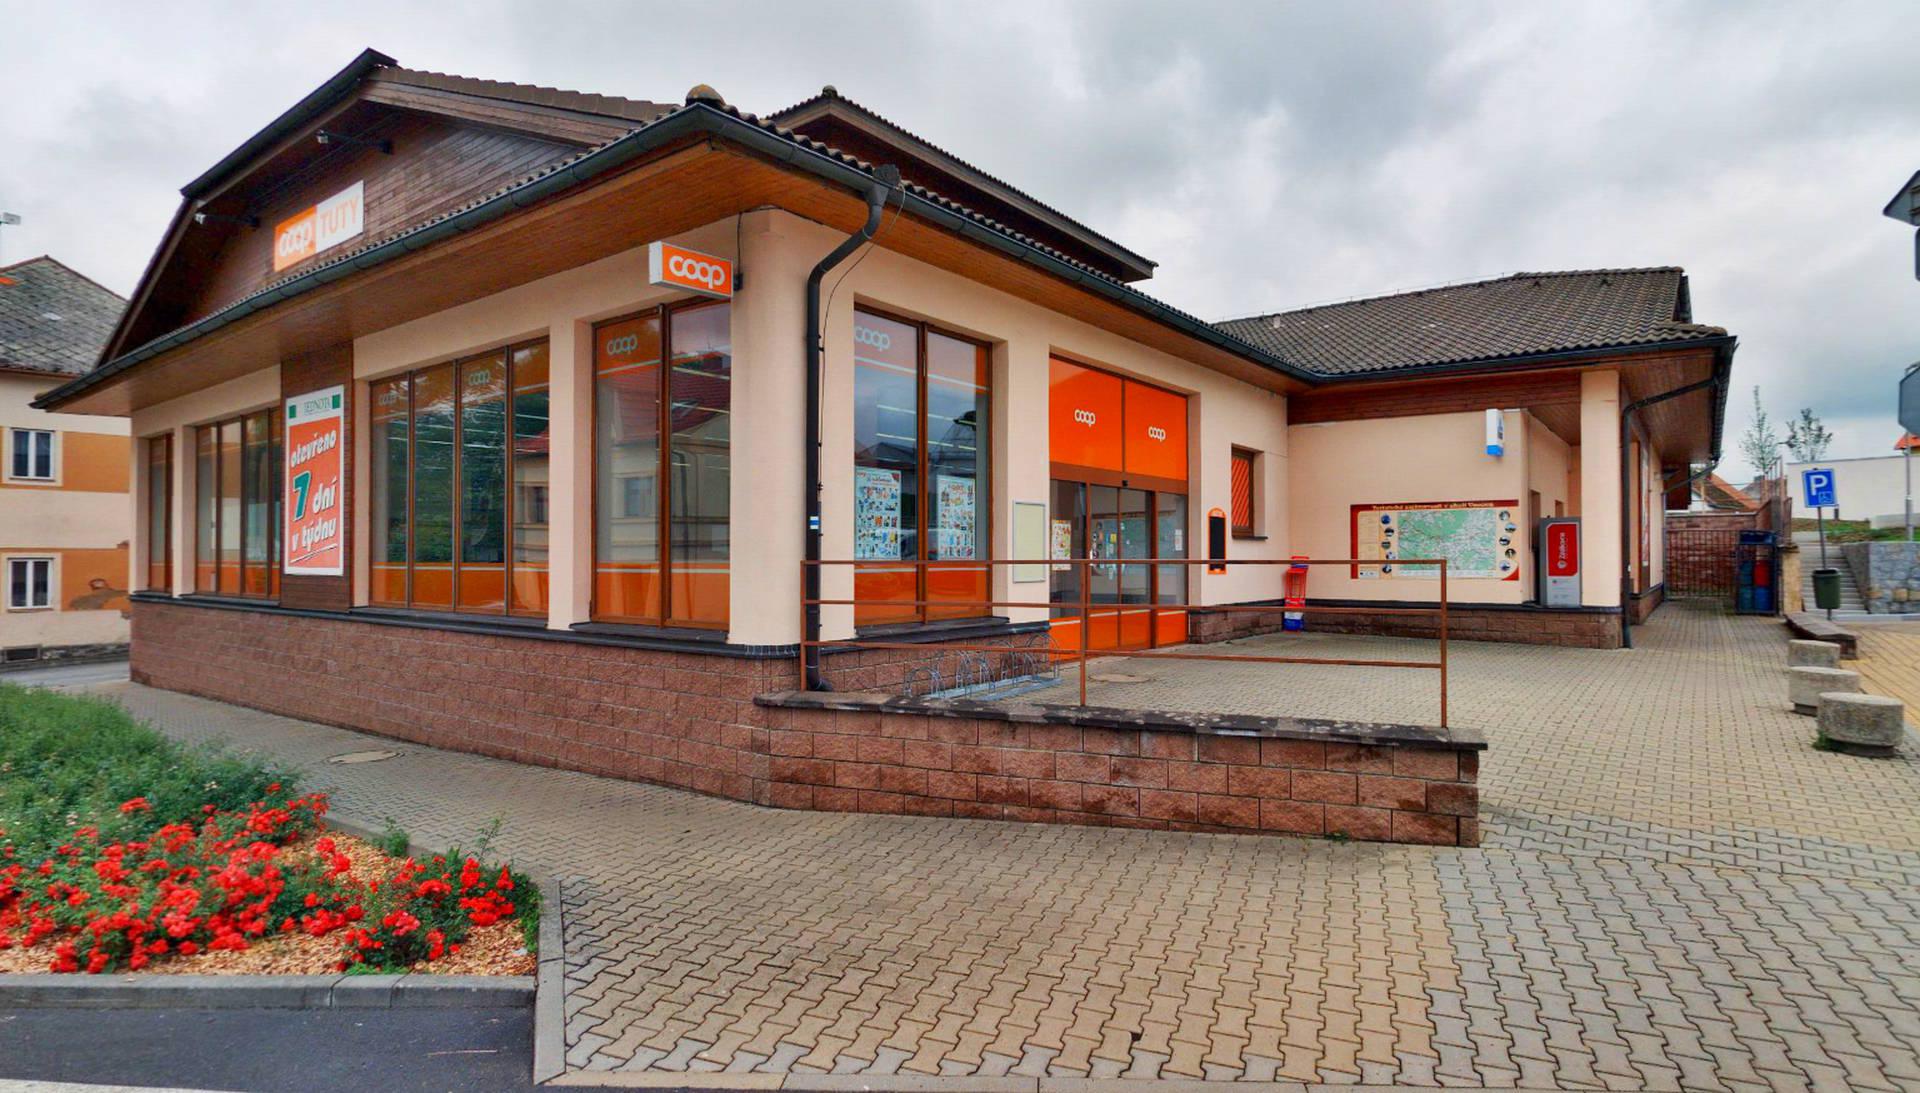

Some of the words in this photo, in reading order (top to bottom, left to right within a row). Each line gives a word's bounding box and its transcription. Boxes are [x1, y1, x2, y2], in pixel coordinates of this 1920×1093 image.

[280, 219, 313, 257] coop
[320, 194, 360, 239] TUTY
[668, 255, 726, 289] coop
[606, 333, 638, 356] coop
[854, 326, 891, 352] coop
[1074, 409, 1096, 427] coop
[290, 429, 337, 468] otevřeno
[1148, 426, 1166, 442] coop
[292, 470, 312, 522] 7
[312, 476, 338, 515] dní
[1809, 474, 1828, 496] P
[291, 532, 299, 552] v
[301, 517, 337, 553] týdnu
